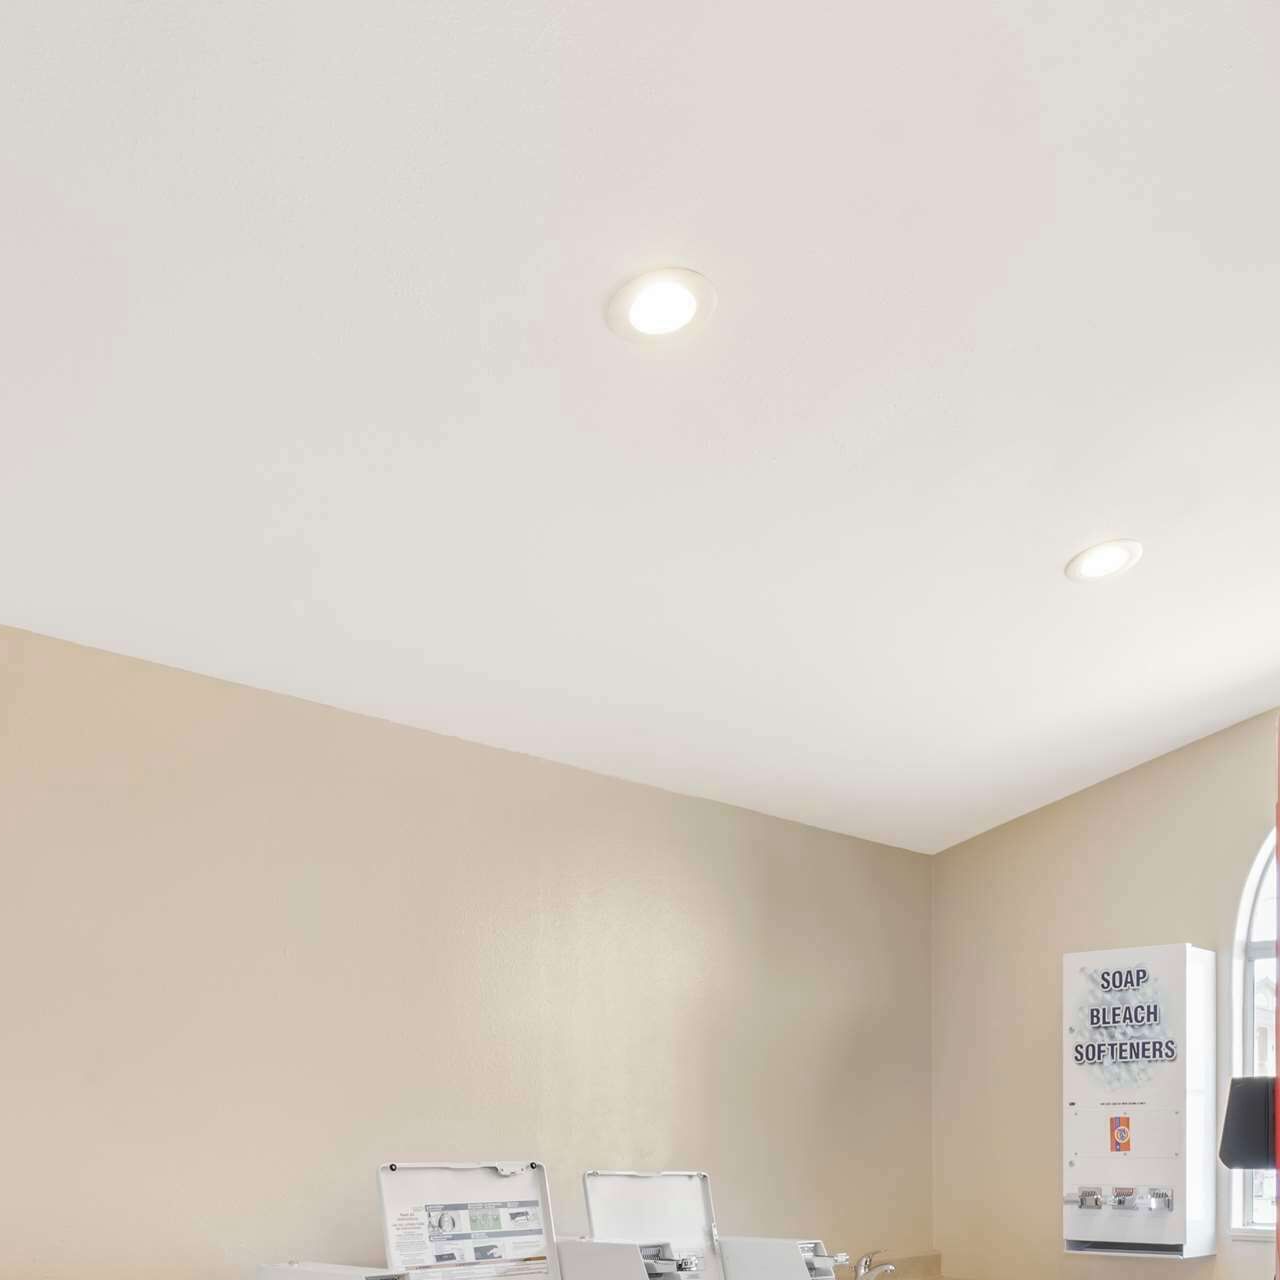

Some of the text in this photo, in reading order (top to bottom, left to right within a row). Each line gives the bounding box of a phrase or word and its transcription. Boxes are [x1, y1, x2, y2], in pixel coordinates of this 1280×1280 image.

[1100, 969, 1147, 990] SOAP
[1089, 1004, 1159, 1026] BLEACH
[1074, 1040, 1176, 1062] SOFTENERS
